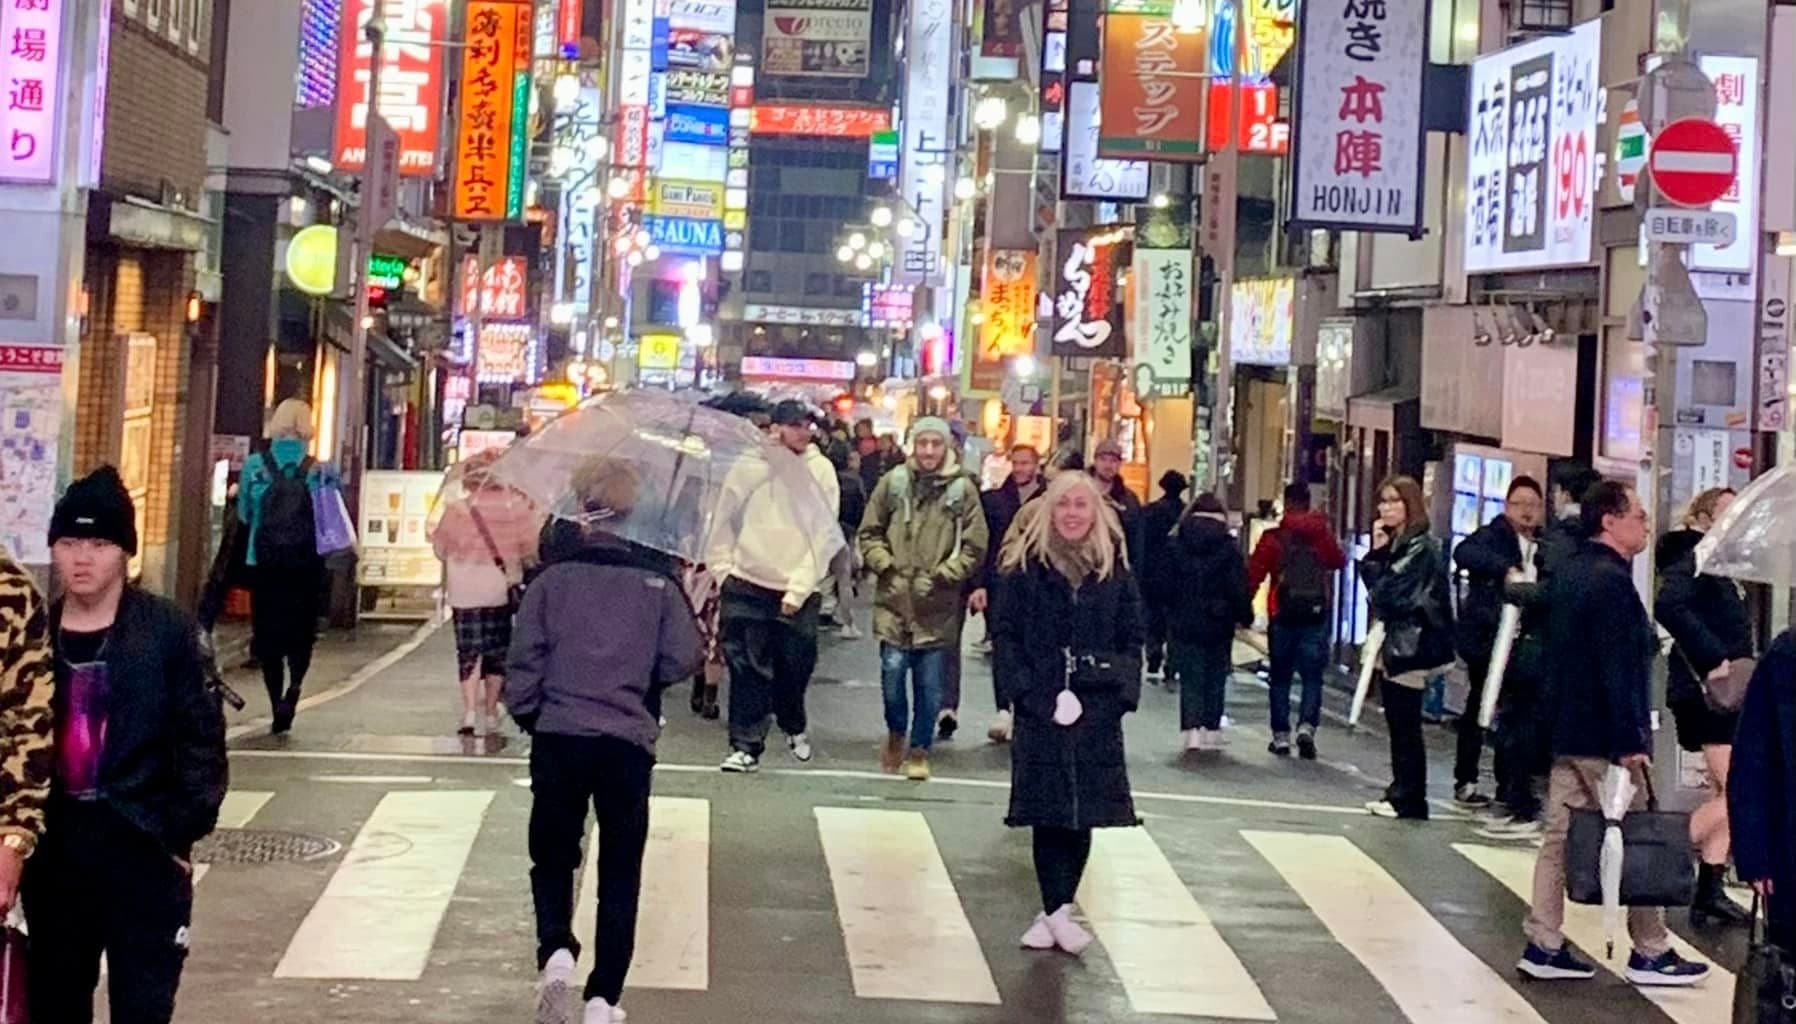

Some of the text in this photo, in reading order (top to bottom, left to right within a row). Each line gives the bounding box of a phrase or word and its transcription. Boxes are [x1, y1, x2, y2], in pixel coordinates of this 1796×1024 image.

[1133, 20, 1180, 136] ステップ
[1249, 122, 1291, 151] 2F
[1334, 74, 1386, 179] 本陣
[1312, 185, 1402, 216] HONJIN
[652, 218, 722, 246] SAUNA
[1652, 216, 1728, 235] 自転車を除く
[1154, 259, 1188, 365] お好み焼き
